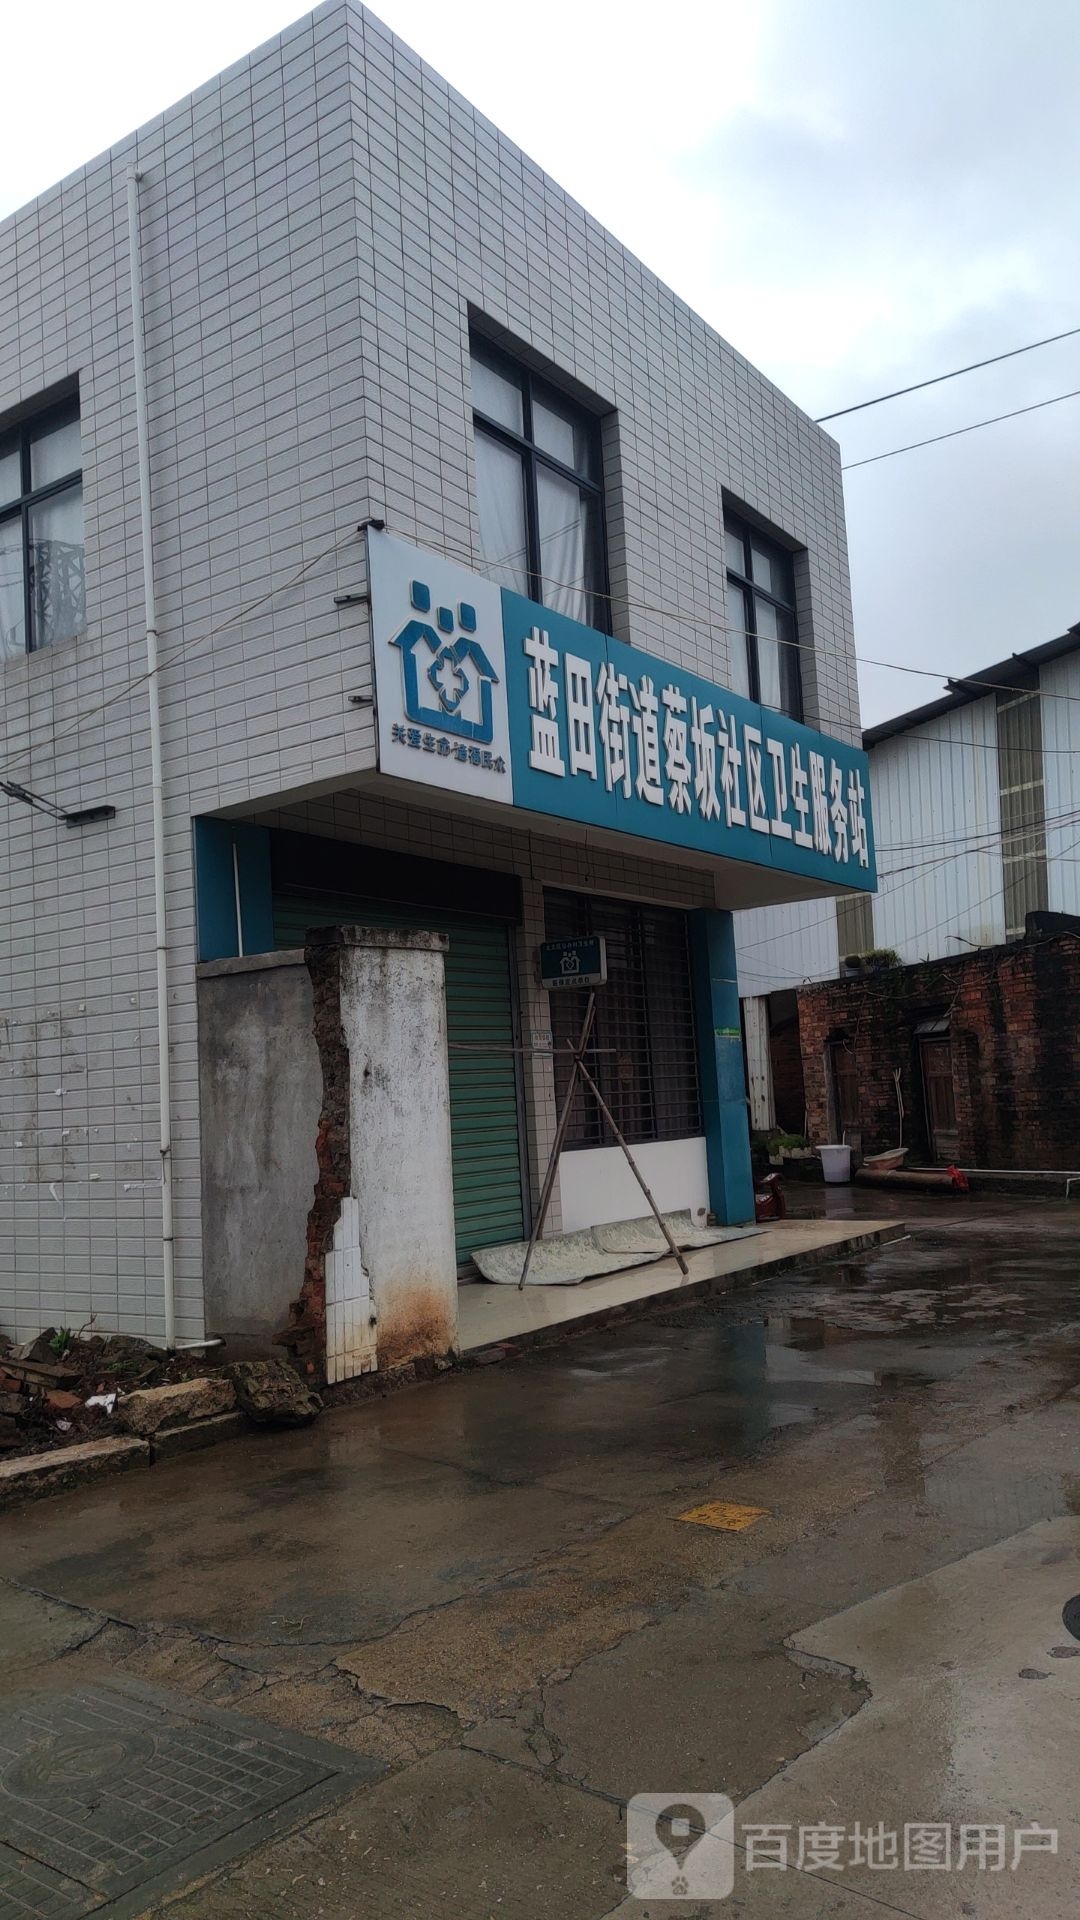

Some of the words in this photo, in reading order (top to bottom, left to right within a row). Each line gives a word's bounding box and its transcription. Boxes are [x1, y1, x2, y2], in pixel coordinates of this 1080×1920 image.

[523, 626, 869, 867] 蓝田街道蔡坂社区卫生服务站
